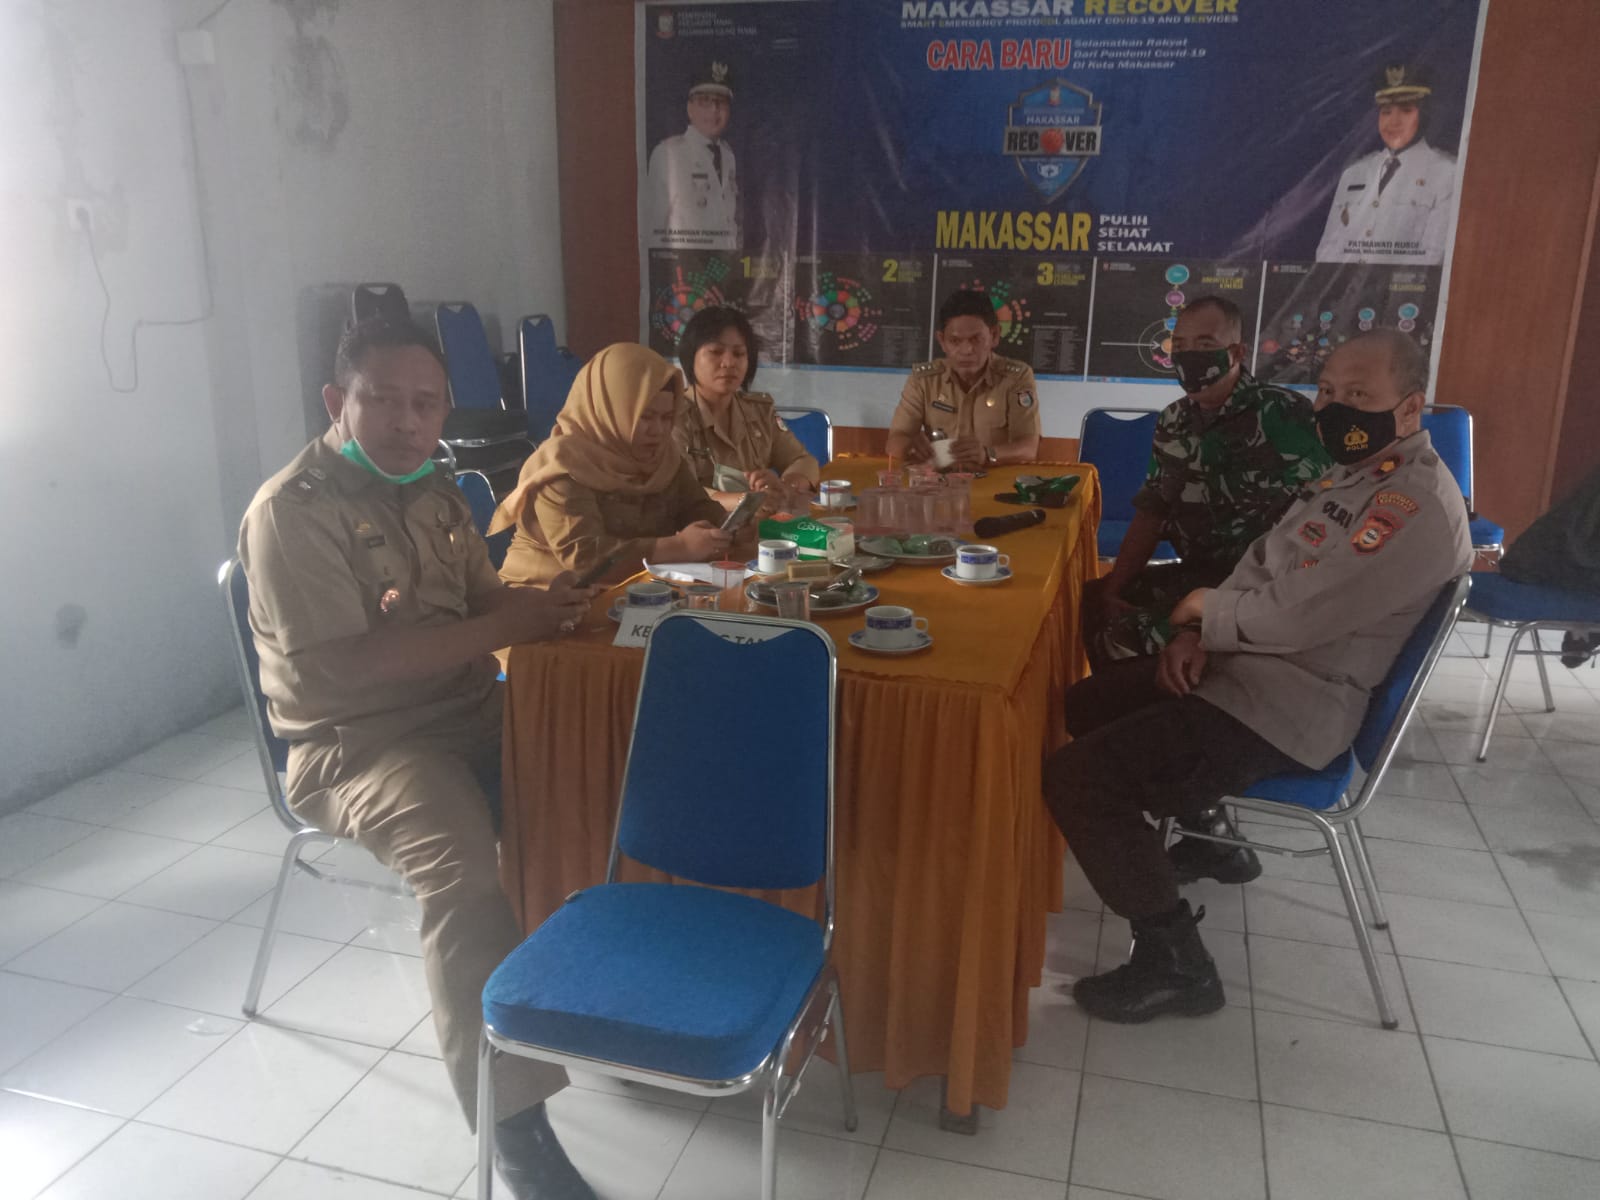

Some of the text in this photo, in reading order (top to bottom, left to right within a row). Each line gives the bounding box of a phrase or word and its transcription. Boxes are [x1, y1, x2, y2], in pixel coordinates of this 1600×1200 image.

[901, 0, 1239, 19] MAKASSAR RECOVER
[939, 18, 1002, 27] EMERGENCY
[1157, 16, 1181, 24] AND
[1146, 37, 1188, 49] Rakyat
[927, 38, 1072, 71] CARA BARU
[1073, 49, 1098, 59] Dari
[1100, 49, 1151, 59] Pandemi
[1118, 60, 1176, 70] Makassar
[1026, 115, 1080, 125] MAKASSAR
[1099, 214, 1148, 226] PULIH
[935, 211, 1092, 251] MAKASSAR
[1098, 227, 1151, 239] SEHAT
[1097, 241, 1174, 253] SELAMAT
[740, 256, 751, 278] 1
[881, 258, 898, 282] 2
[1037, 261, 1054, 286] 3
